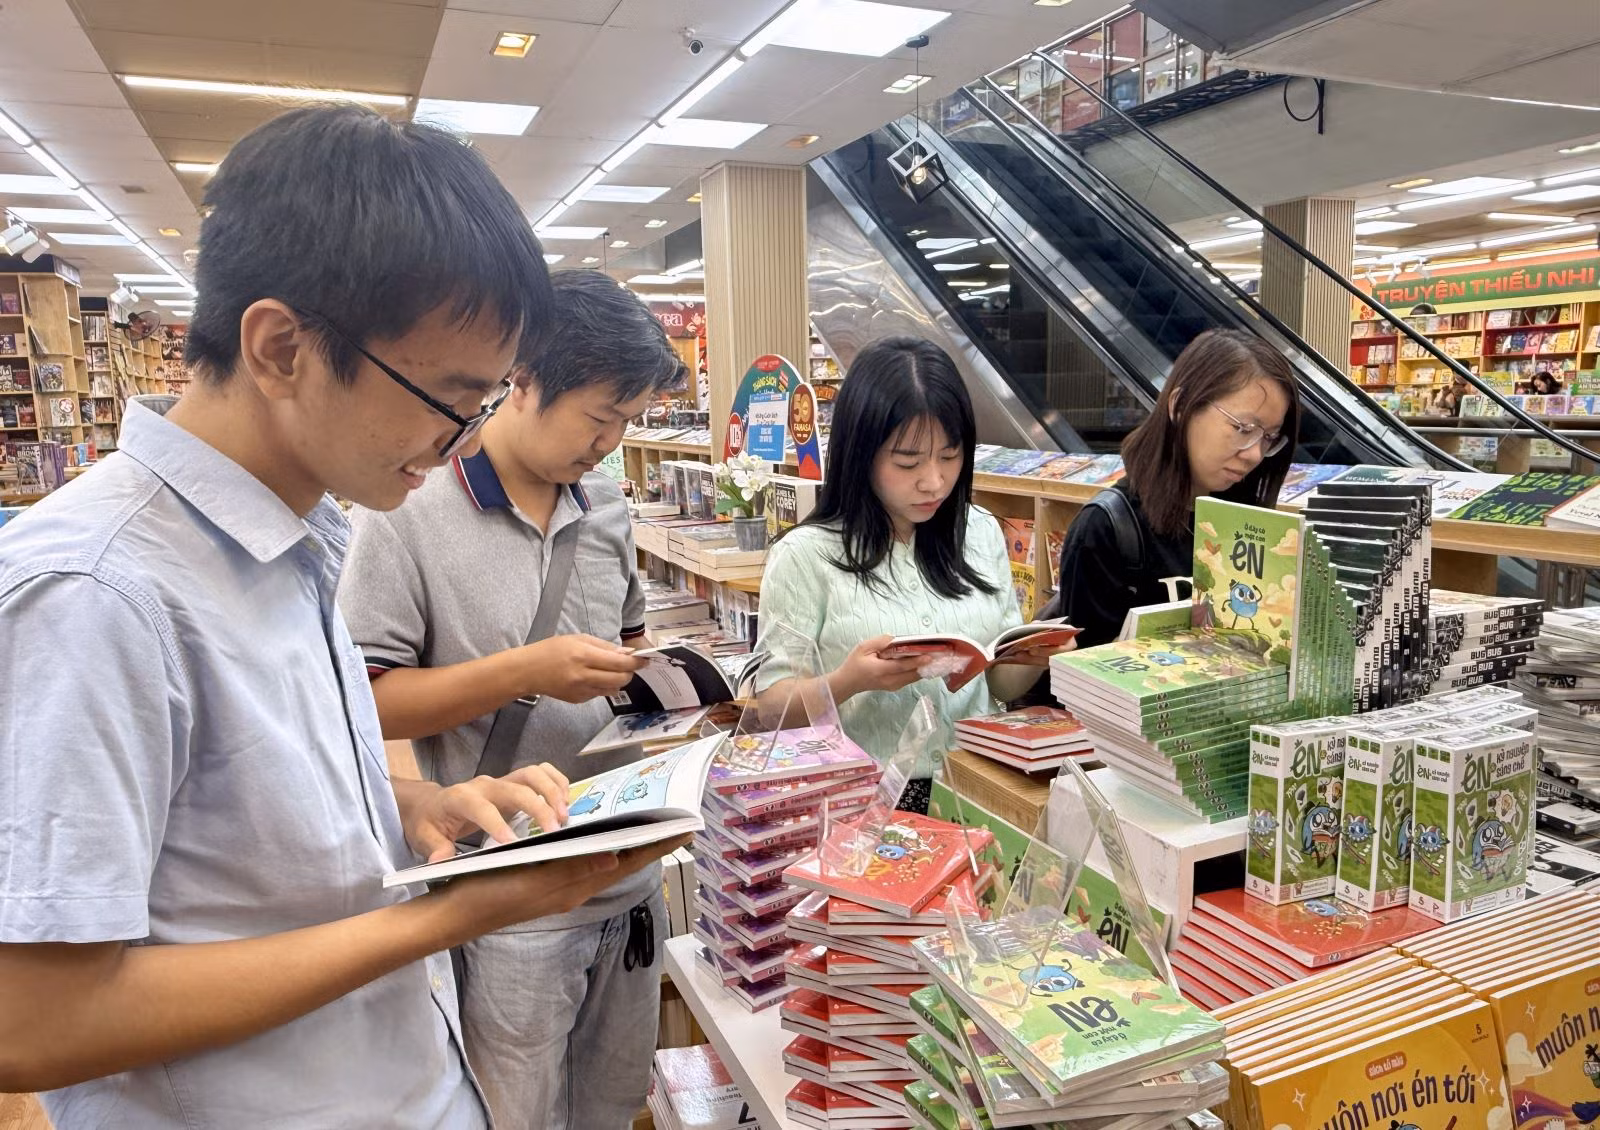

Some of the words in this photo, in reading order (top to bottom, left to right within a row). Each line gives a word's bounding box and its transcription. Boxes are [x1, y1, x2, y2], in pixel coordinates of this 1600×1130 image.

[1376, 280, 1466, 304] TRUYỆN
[1470, 269, 1542, 295] THIẾU
[1548, 267, 1595, 288] NHI
[776, 495, 796, 512] COREY
[1484, 610, 1499, 620] BUG
[1499, 608, 1515, 617] BUG
[1484, 623, 1498, 633] BUG
[1499, 620, 1514, 630] BUG
[1479, 635, 1494, 645] BUG
[1494, 632, 1509, 642] BUG
[1471, 649, 1486, 659] BUG
[1486, 647, 1502, 657] BUG
[1462, 664, 1477, 674] BUG
[1477, 661, 1493, 672] BUG
[1451, 678, 1467, 687] BUG
[1467, 675, 1483, 685] BUG
[1536, 1012, 1586, 1069] muôn
[1316, 1100, 1369, 1130] uôn
[1371, 1081, 1408, 1122] nơi
[1411, 1069, 1438, 1108] én
[1443, 1065, 1475, 1104] tới
